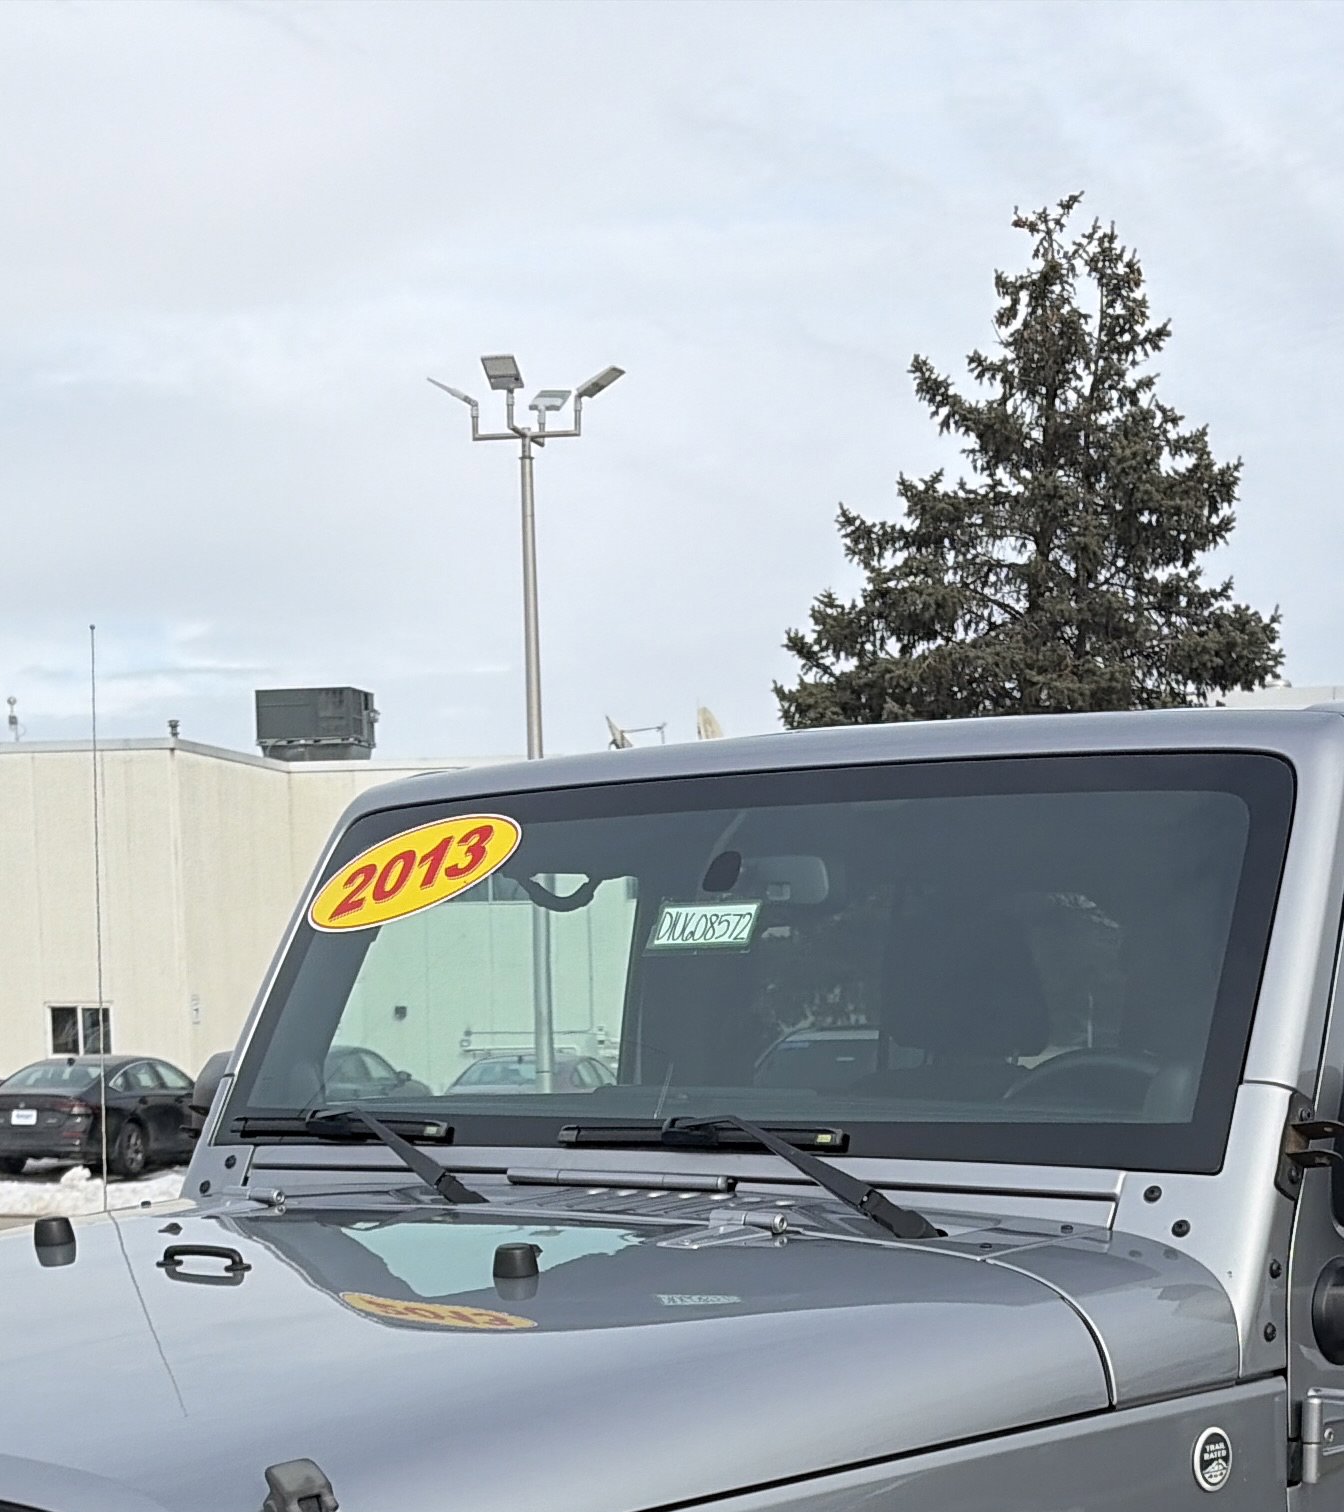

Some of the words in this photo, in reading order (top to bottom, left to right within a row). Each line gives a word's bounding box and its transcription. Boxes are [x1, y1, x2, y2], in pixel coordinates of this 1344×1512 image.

[328, 825, 494, 922] 2013
[1205, 1442, 1226, 1452] TRAIL
[1203, 1450, 1227, 1460] RATED
